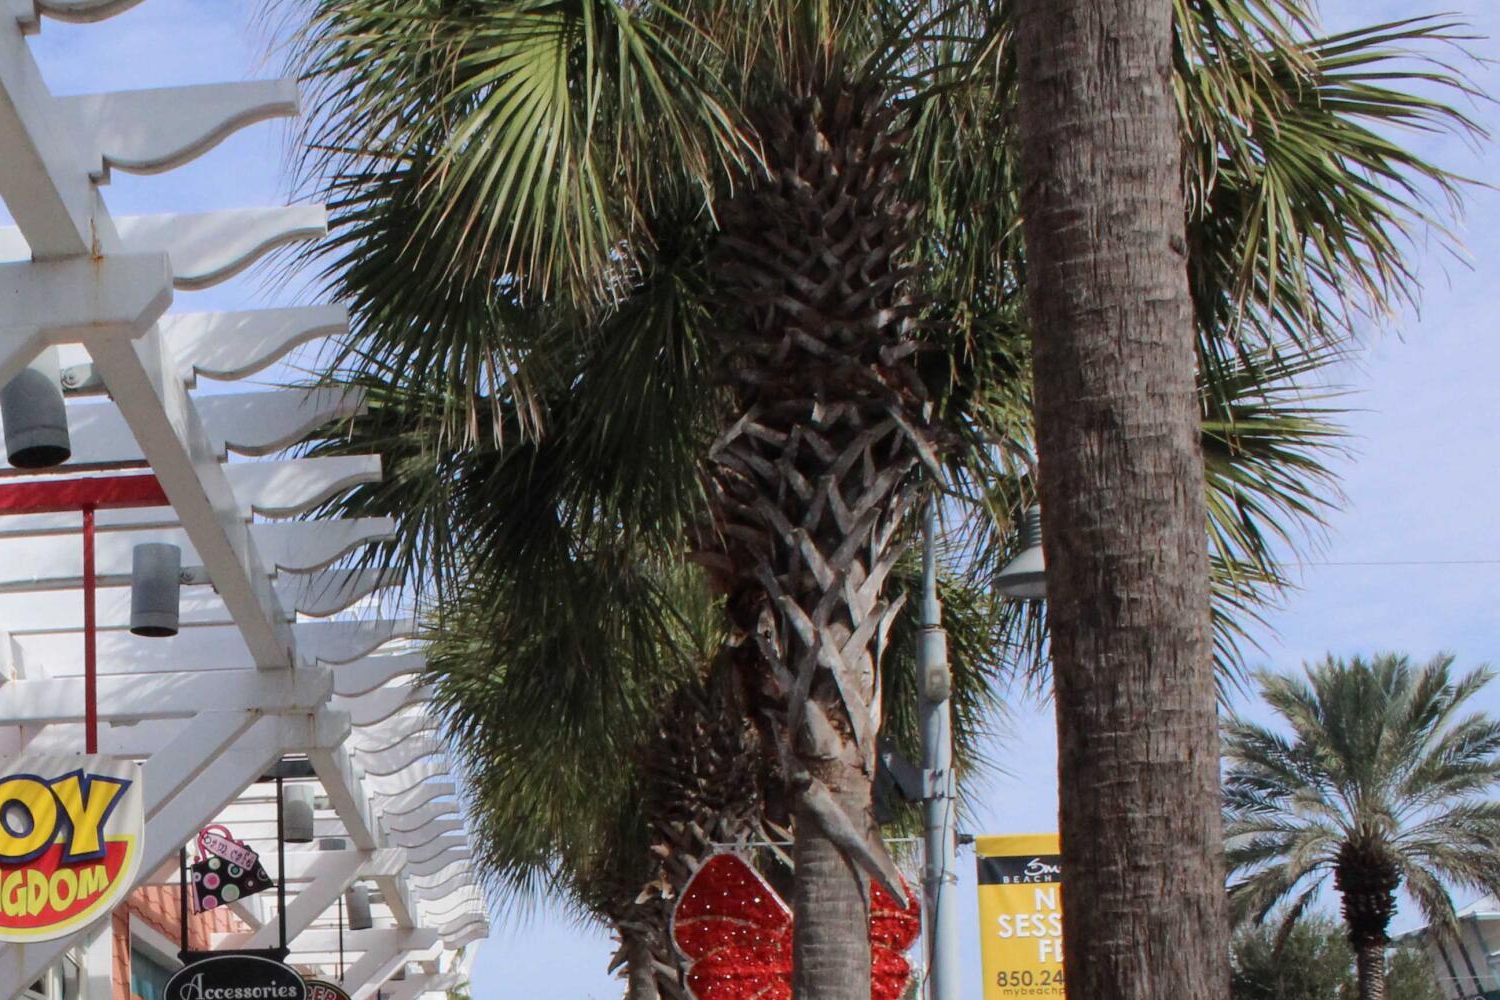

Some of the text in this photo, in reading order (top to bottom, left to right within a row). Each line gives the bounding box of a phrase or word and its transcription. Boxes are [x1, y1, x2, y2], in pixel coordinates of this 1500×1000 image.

[1002, 874, 1052, 885] BEACH
[997, 912, 1062, 939] SESS
[997, 969, 1065, 988] 850.24
[1003, 985, 1066, 998] mybeachp
